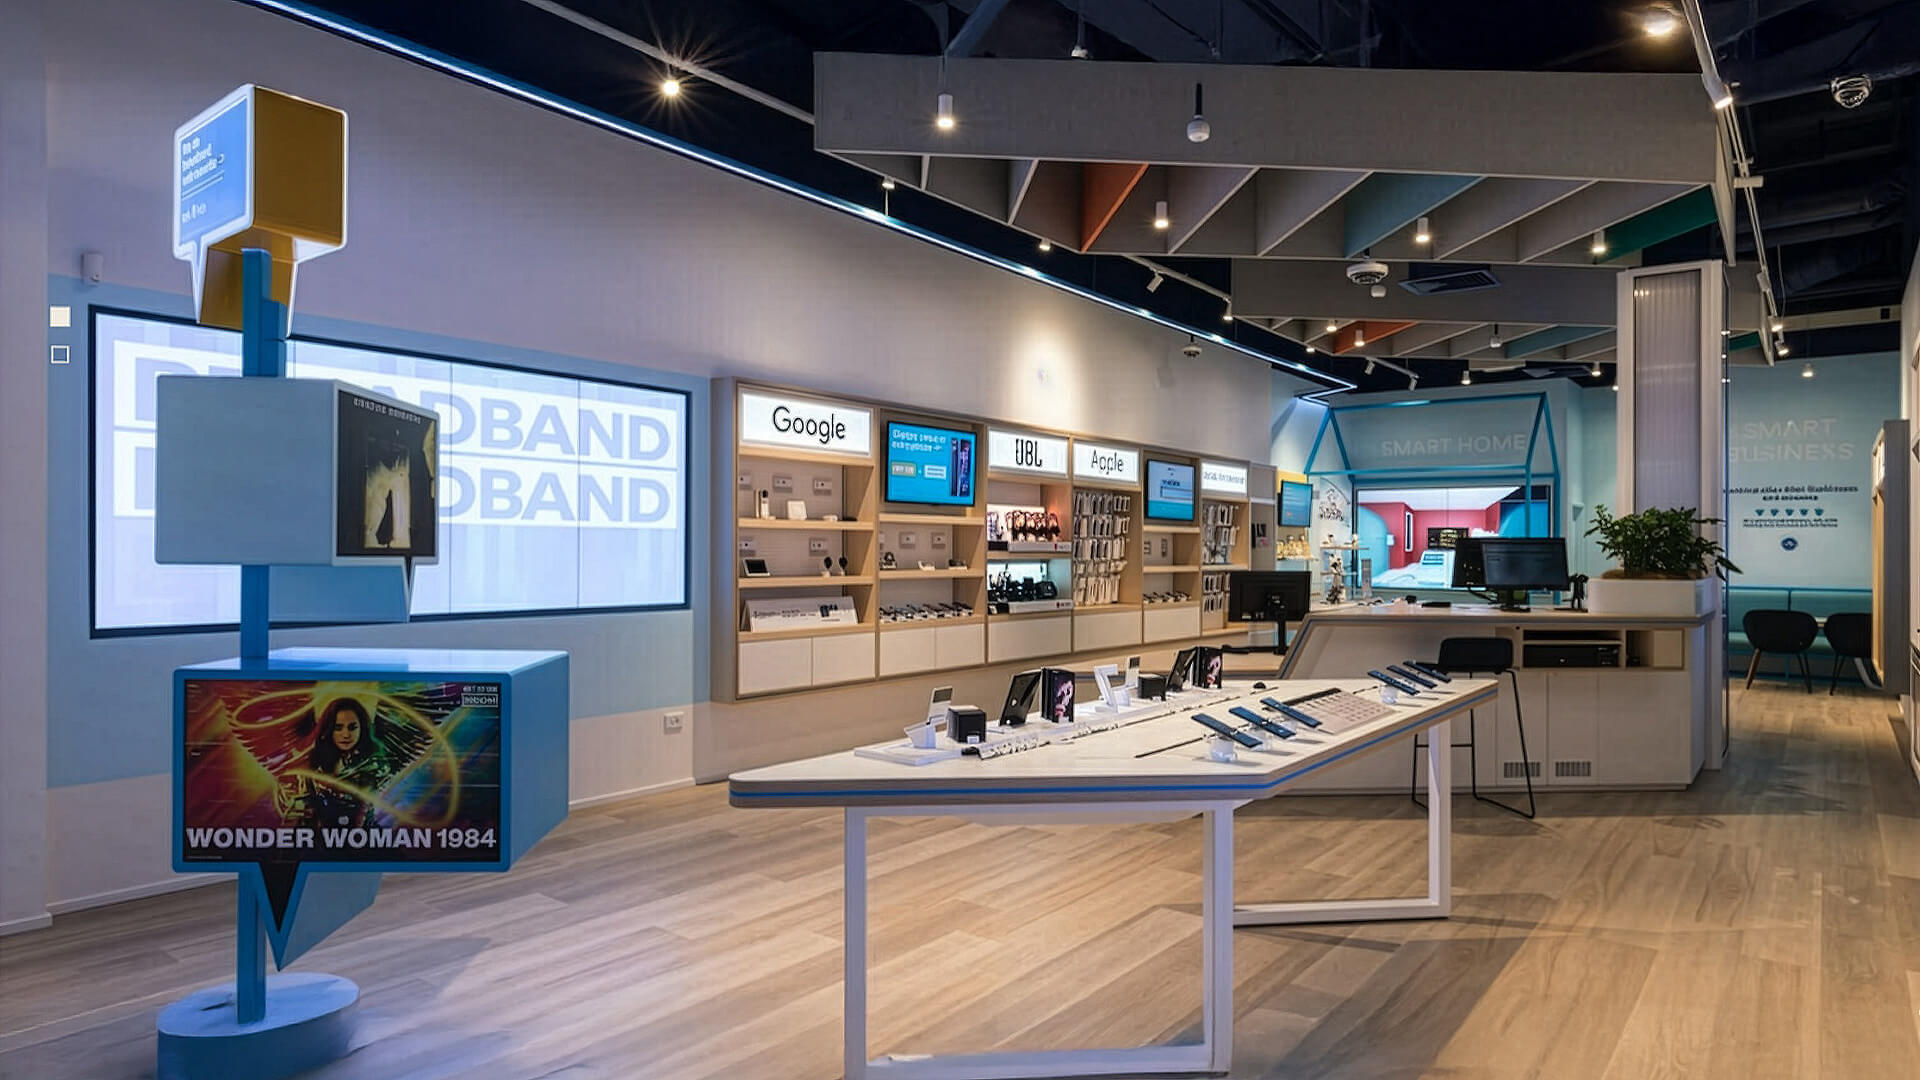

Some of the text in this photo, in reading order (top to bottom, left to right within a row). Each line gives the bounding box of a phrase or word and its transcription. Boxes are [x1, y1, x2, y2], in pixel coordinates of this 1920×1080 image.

[773, 406, 845, 444] Google
[1743, 417, 1836, 440] SMART
[1381, 433, 1526, 457] SMART HOME
[186, 827, 497, 849] WONDER WOMAN 1984
